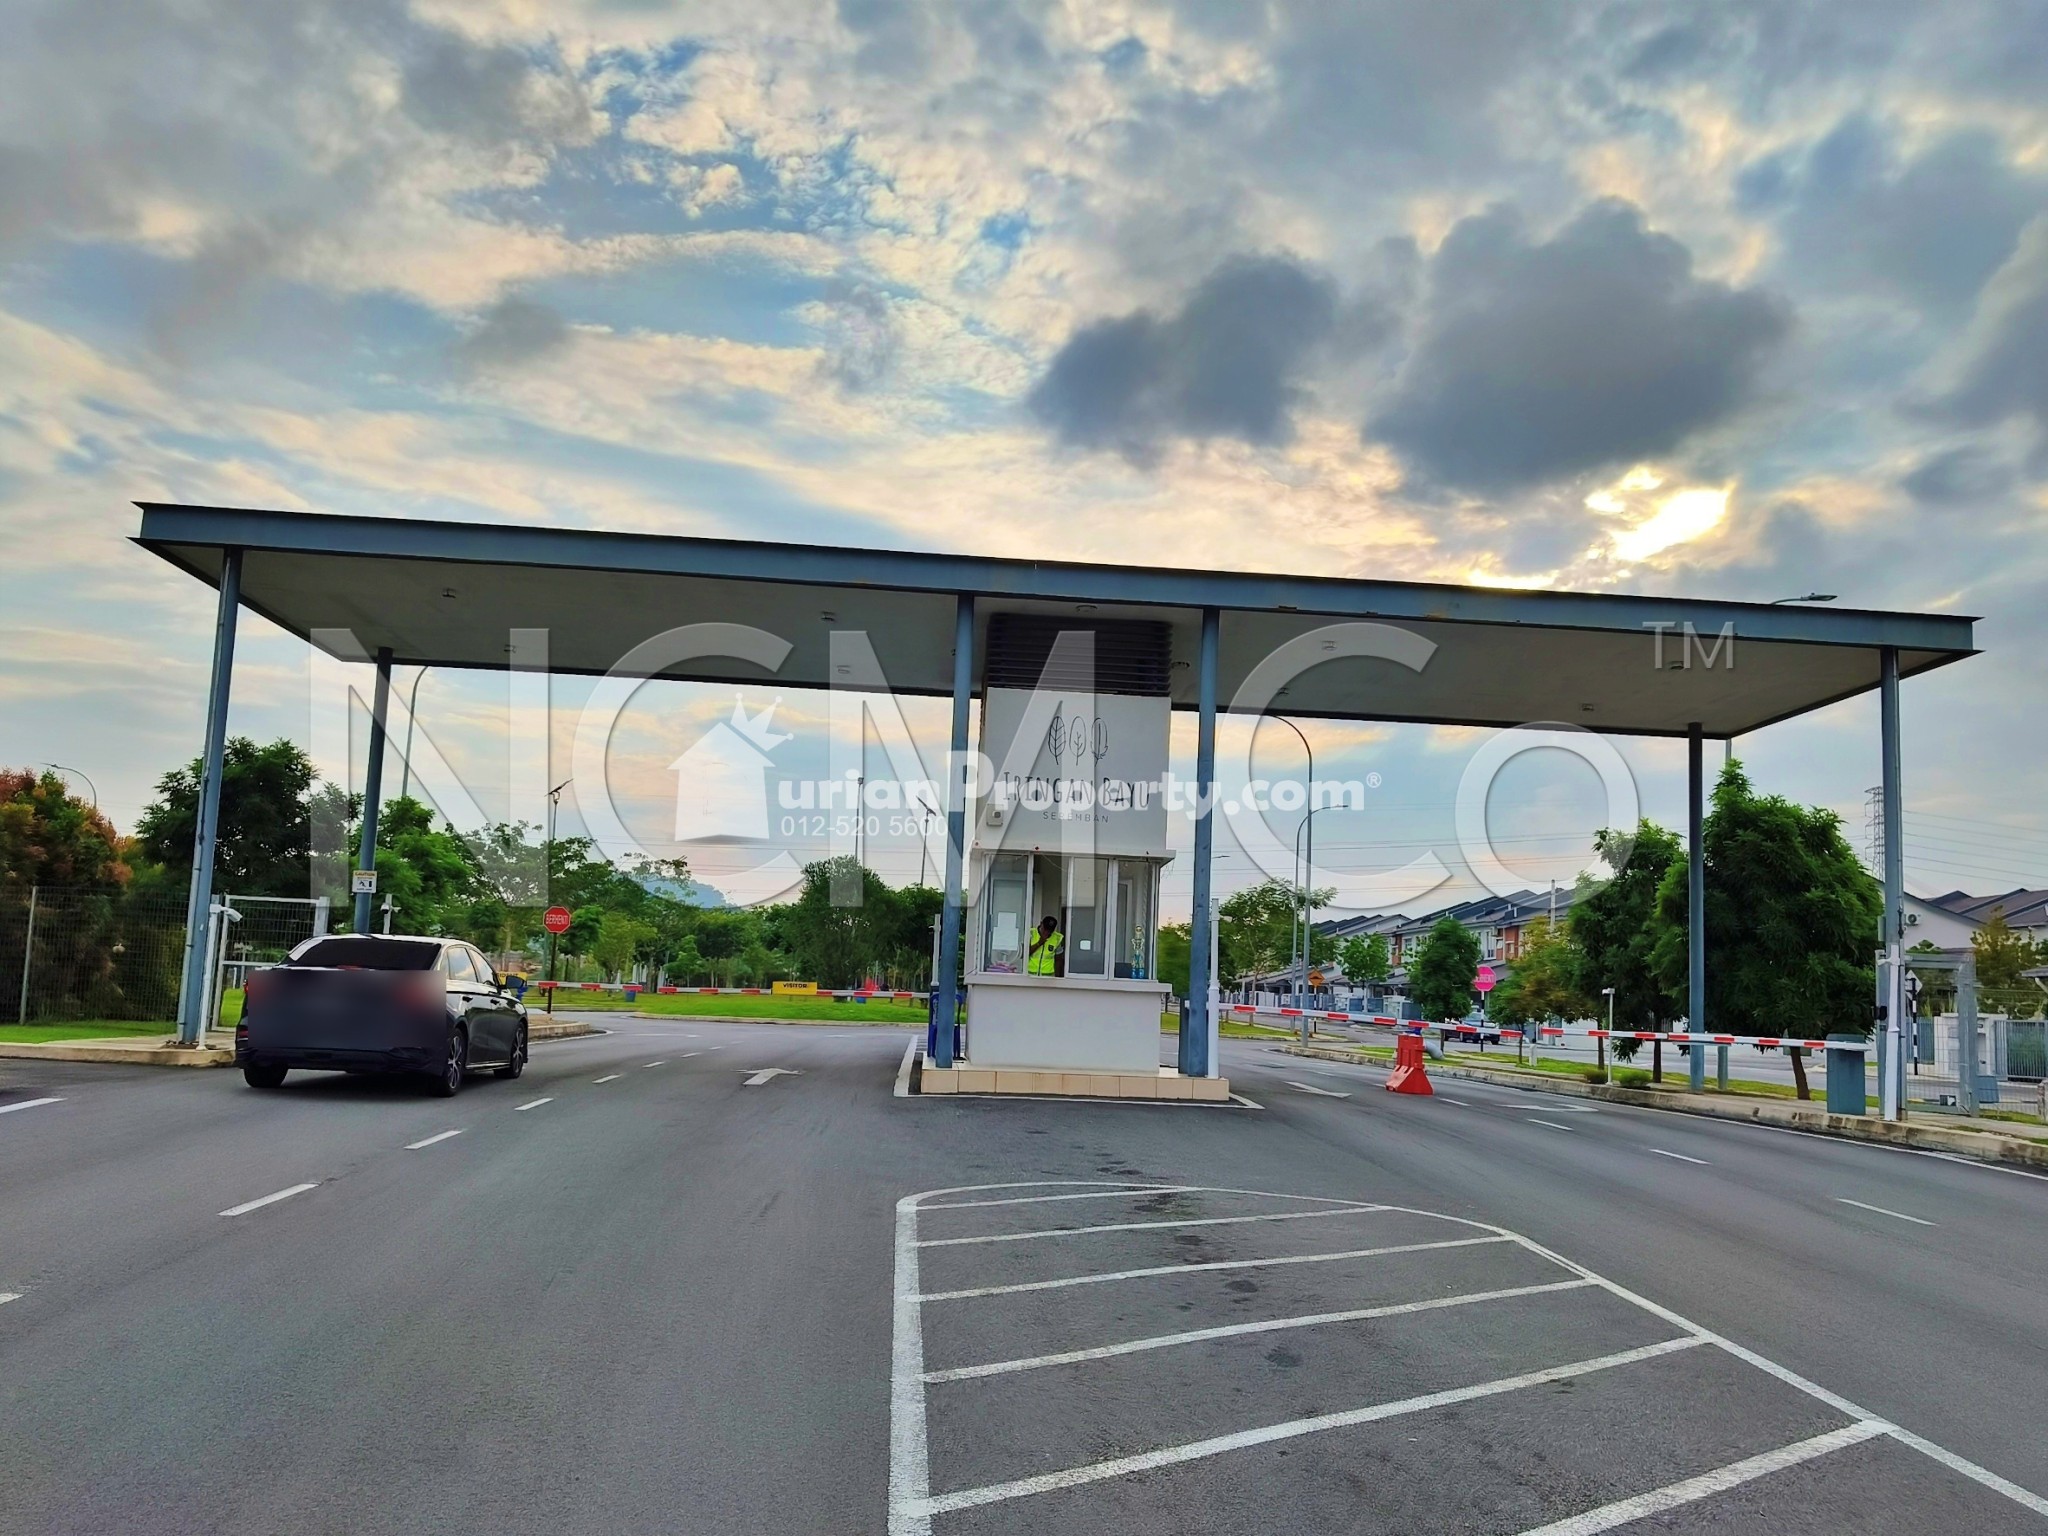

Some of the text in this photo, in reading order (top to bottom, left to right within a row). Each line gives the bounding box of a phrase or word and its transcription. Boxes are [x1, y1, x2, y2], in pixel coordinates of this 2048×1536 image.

[1003, 772, 1150, 808] IRINGAN BAYU
[545, 914, 569, 925] BERHENTI
